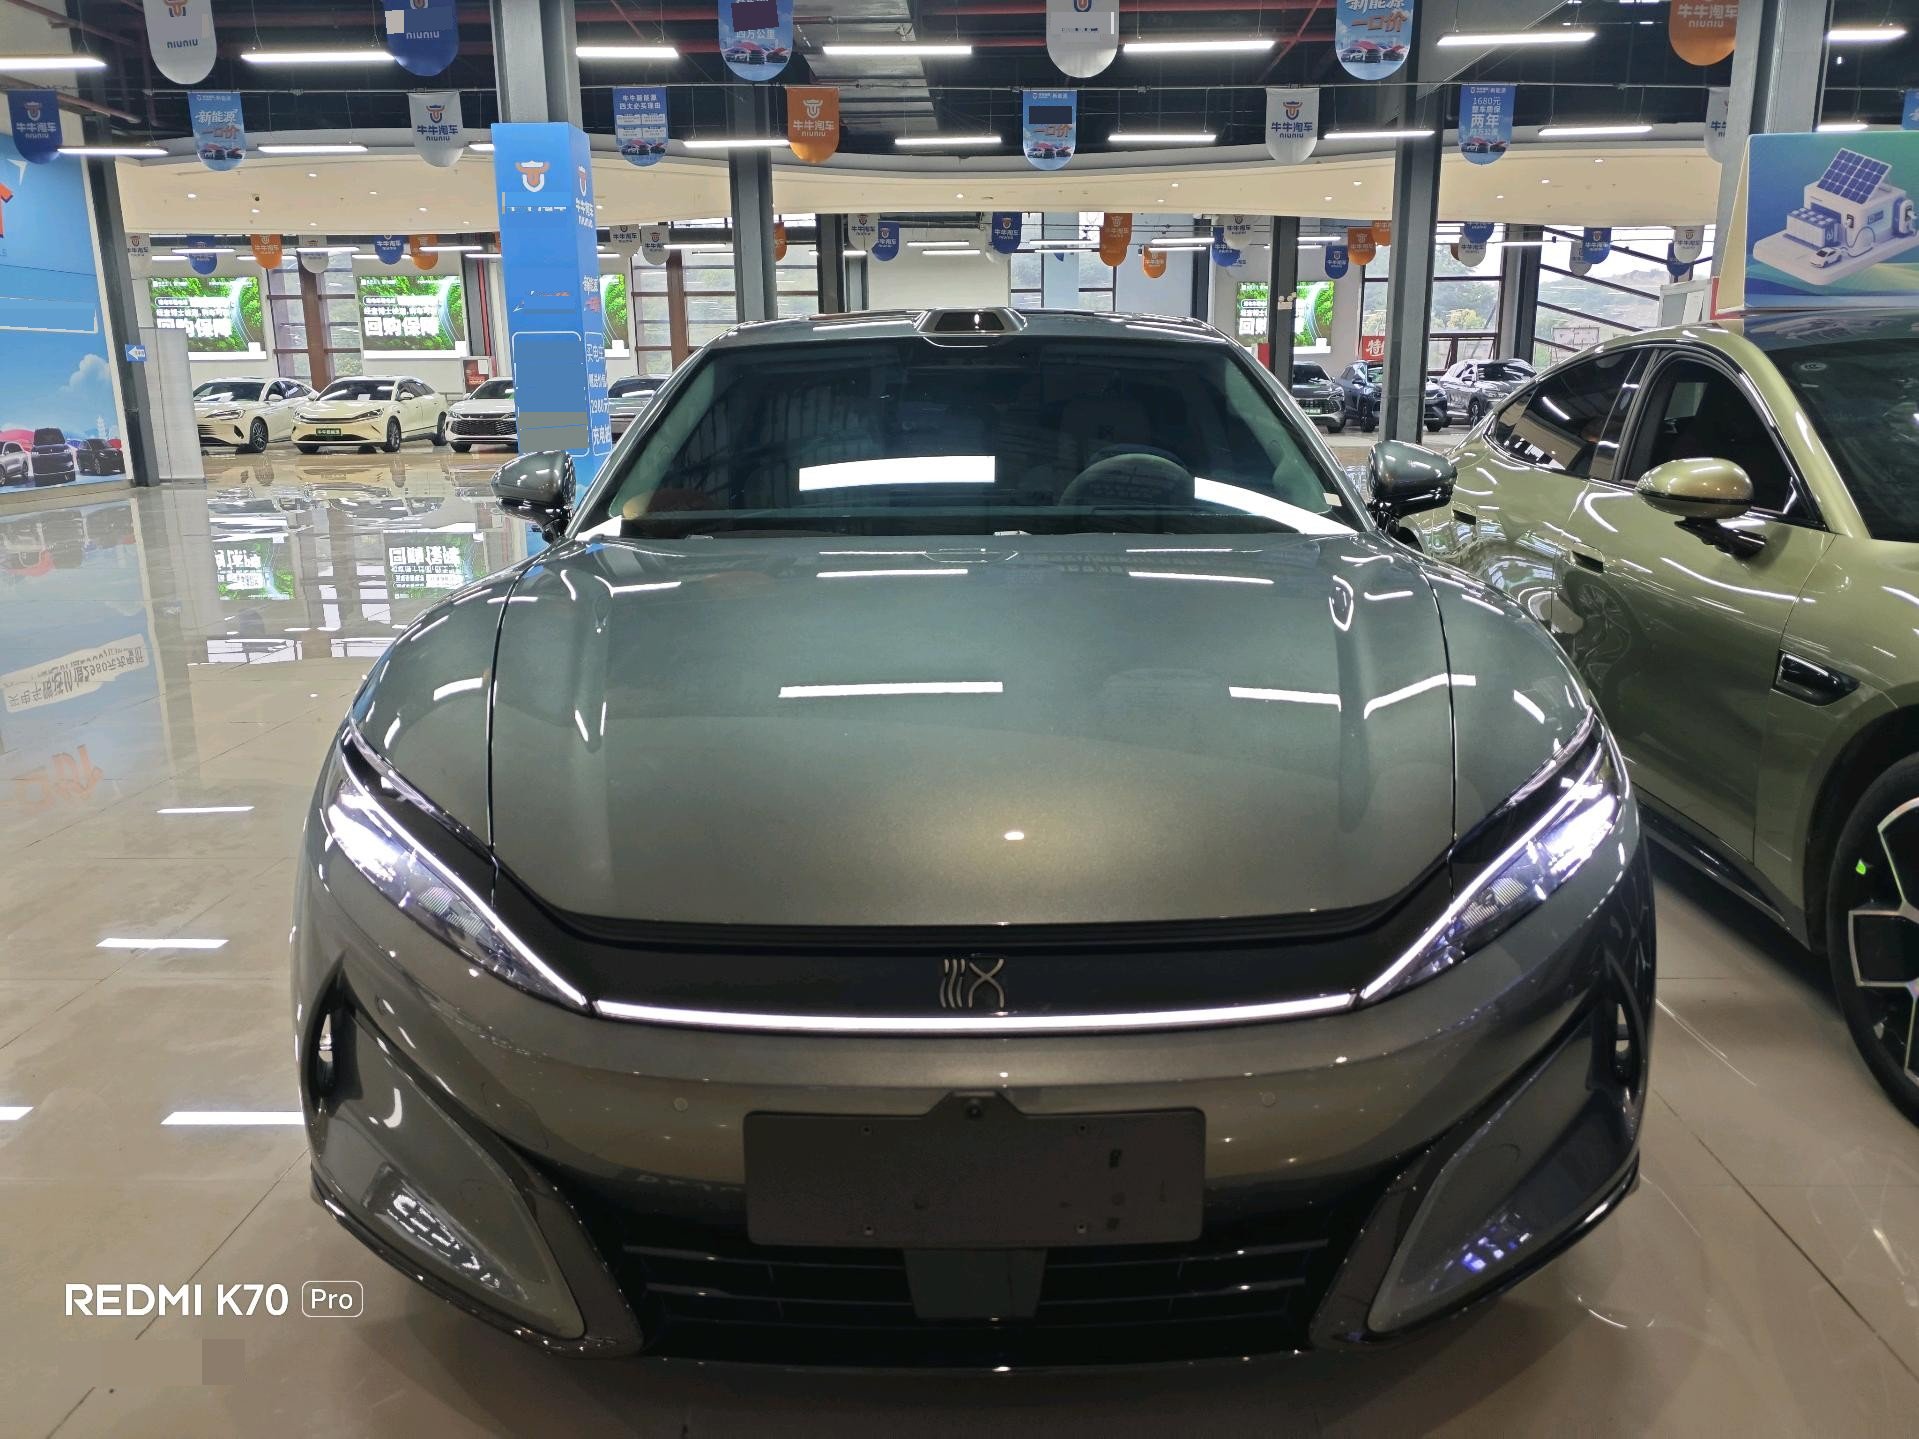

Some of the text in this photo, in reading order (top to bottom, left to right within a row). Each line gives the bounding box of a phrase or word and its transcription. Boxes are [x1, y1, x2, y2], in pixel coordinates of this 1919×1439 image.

[1678, 4, 1738, 19] 牛牛淘车
[1351, 11, 1407, 32] 一口价
[196, 109, 238, 126] 新能源
[1472, 114, 1500, 128] 两年
[793, 120, 835, 131] 牛牛淘车
[1271, 121, 1313, 132] 牛牛淘车
